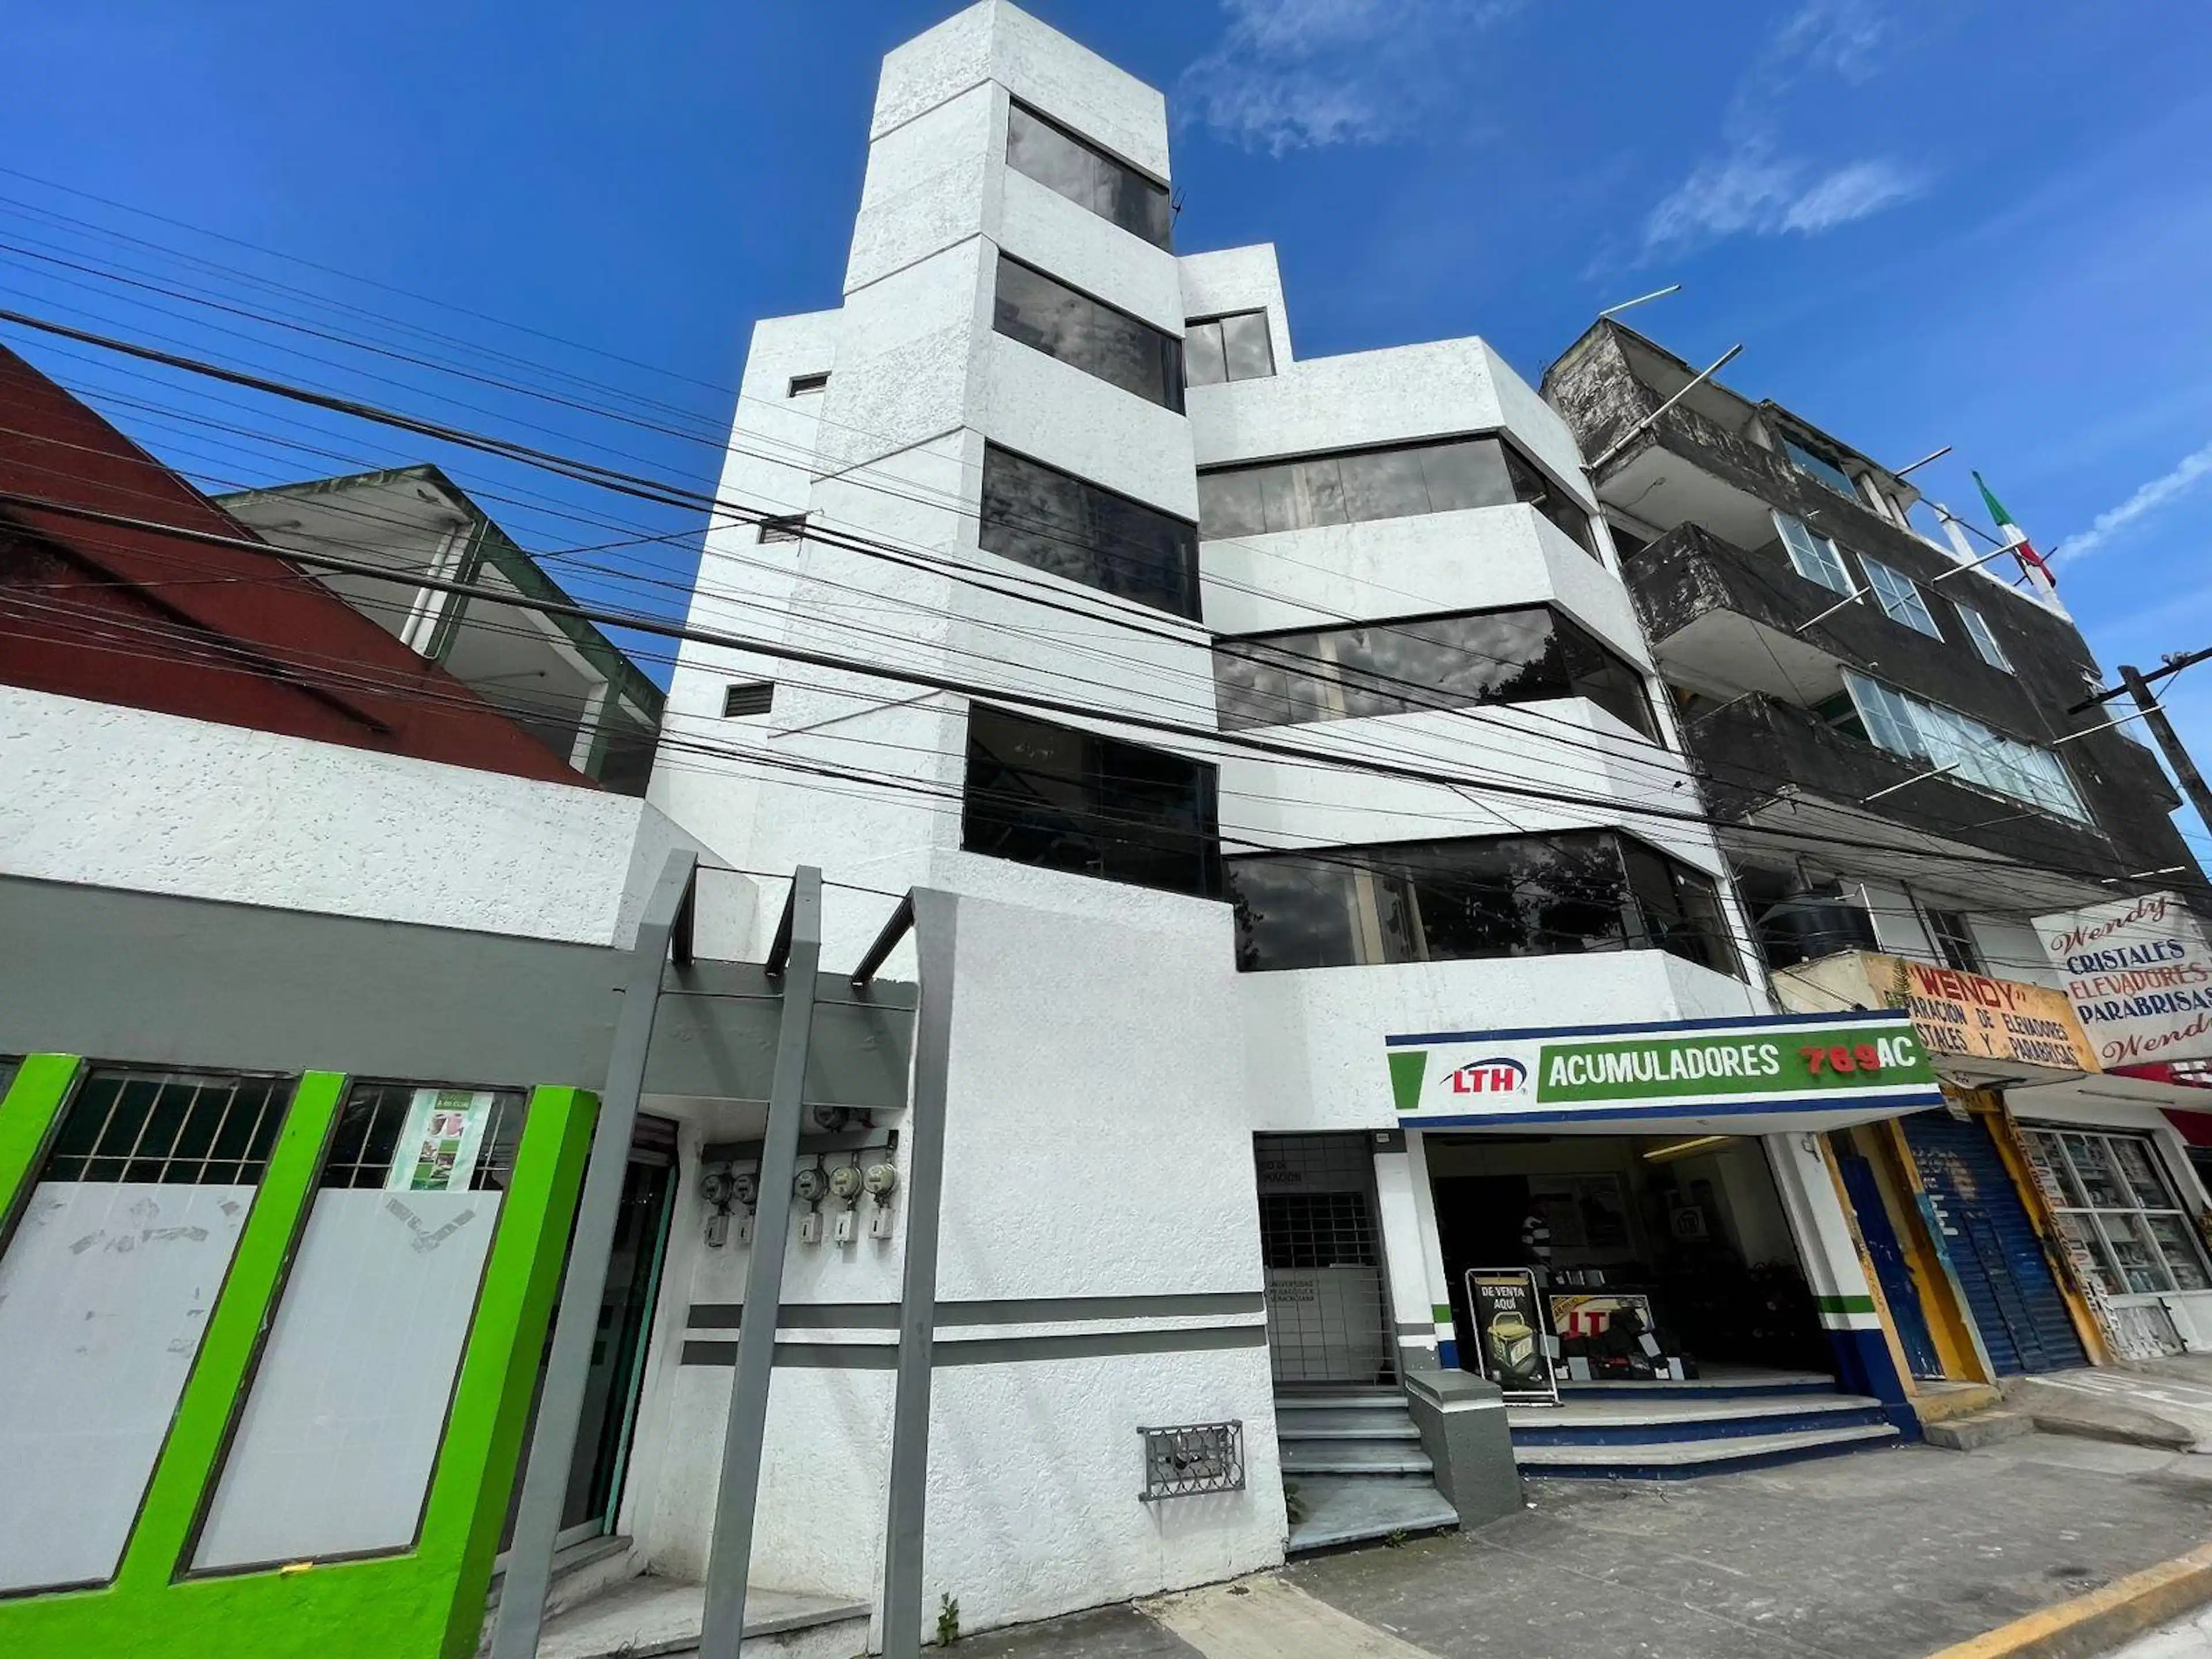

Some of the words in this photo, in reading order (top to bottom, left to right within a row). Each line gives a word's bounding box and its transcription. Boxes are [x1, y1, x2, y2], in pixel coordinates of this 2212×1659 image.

[2051, 896, 2167, 956] Wendy
[2067, 939, 2186, 975] CRISTALES
[2069, 962, 2209, 1000] ELEVADORES
[1976, 1007, 1994, 1029] DE
[2001, 1012, 2069, 1041] ELEVADORES
[2102, 1013, 2212, 1063] Wend
[1979, 1032, 1993, 1056] Y
[2008, 1036, 2081, 1066] PARABRISAS
[1453, 1068, 1514, 1093] LTH
[1548, 1044, 1781, 1087] ACUMULADORES
[1481, 1286, 1495, 1297] DE
[1494, 1286, 1526, 1297] VENTA
